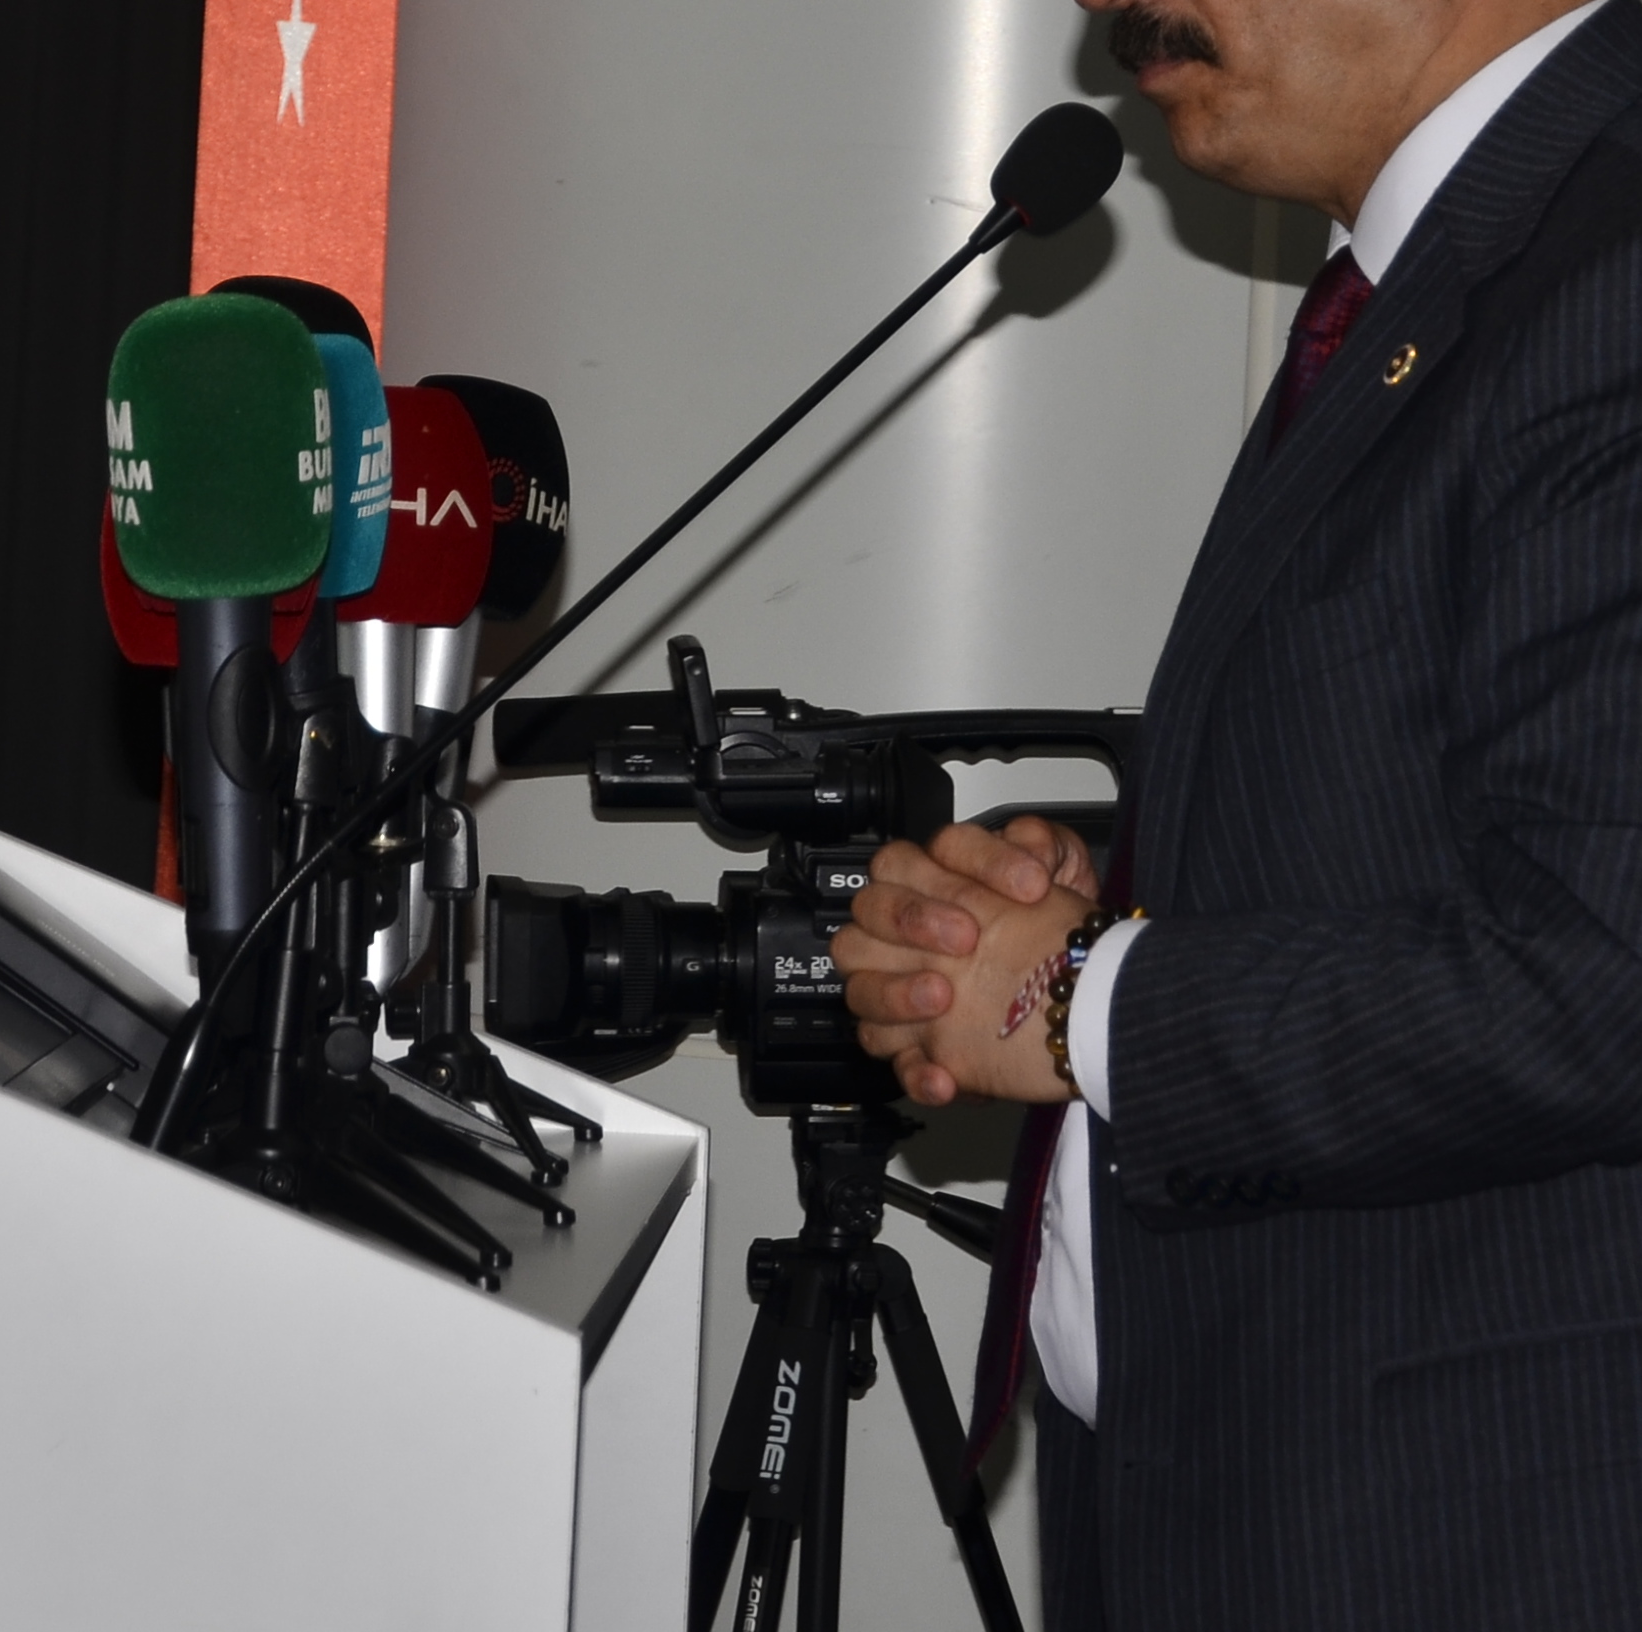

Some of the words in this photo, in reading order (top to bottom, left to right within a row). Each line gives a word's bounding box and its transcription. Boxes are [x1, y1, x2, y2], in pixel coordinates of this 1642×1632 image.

[829, 873, 869, 889] SO
[775, 956, 803, 970] 24x
[817, 984, 843, 994] WIDE
[743, 1575, 763, 1632] ZOME
